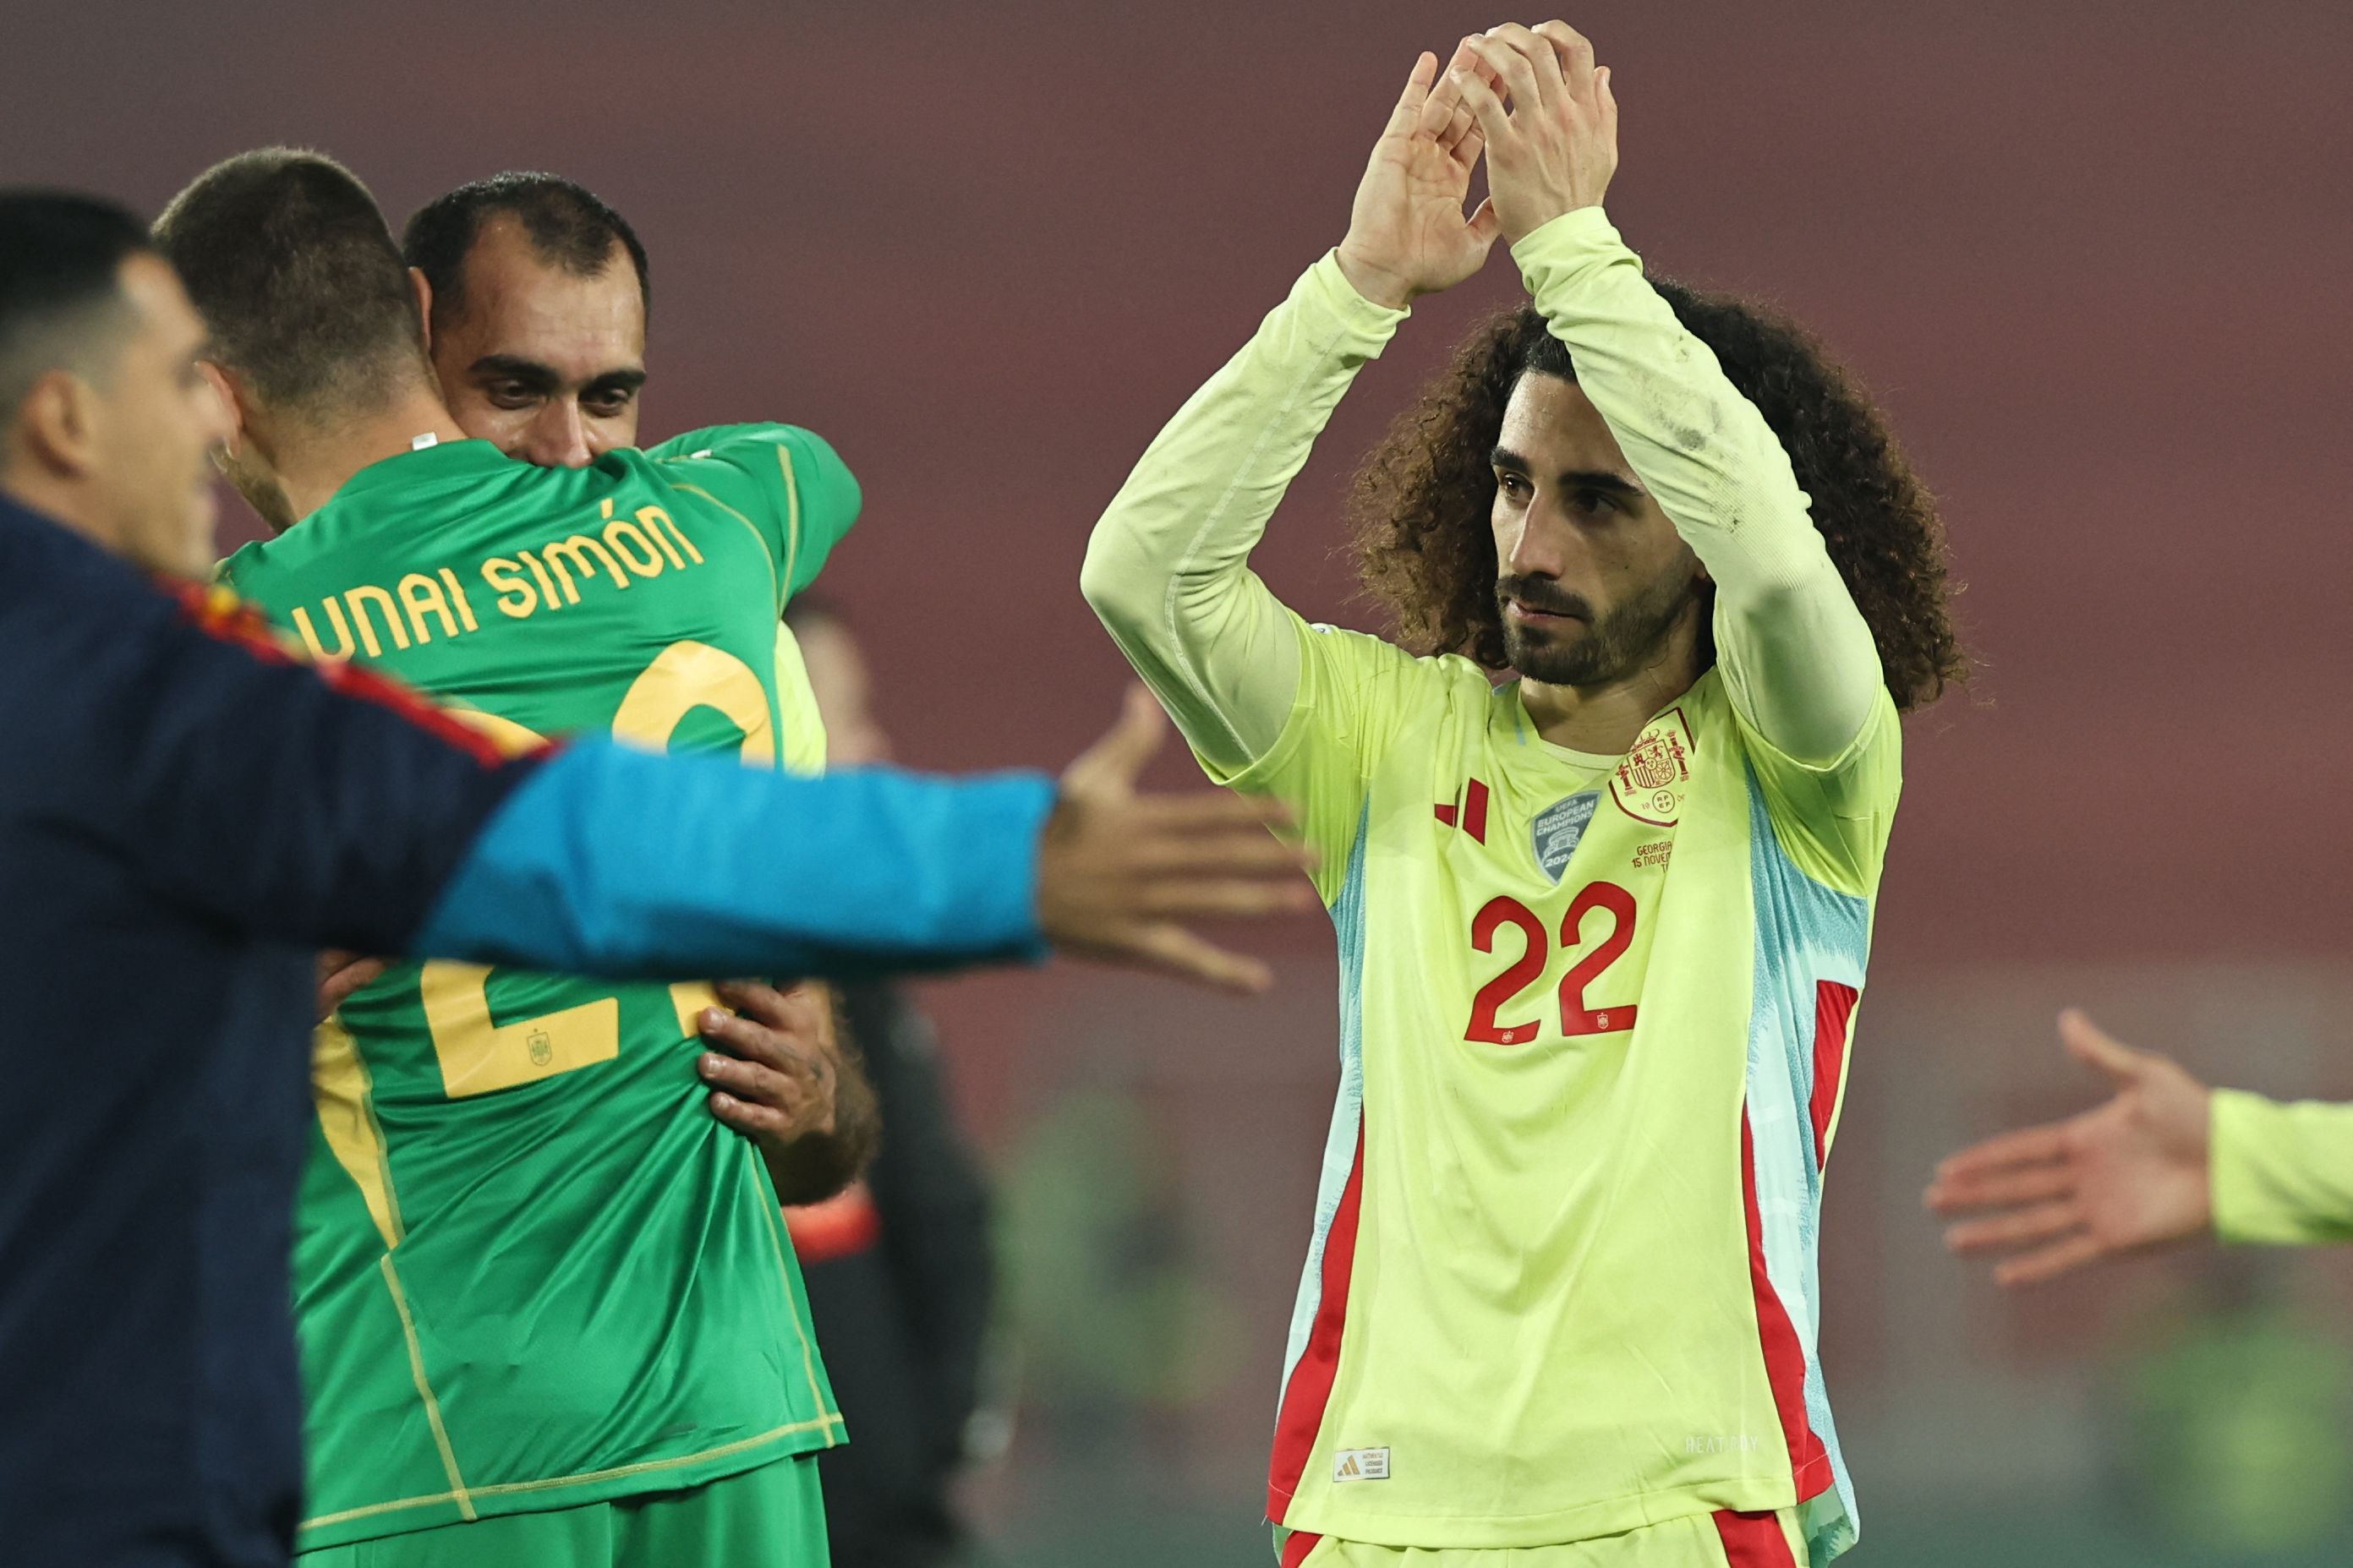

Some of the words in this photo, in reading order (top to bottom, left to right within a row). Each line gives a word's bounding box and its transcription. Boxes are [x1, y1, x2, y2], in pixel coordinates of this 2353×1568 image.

[292, 568, 479, 665] UNAI
[480, 497, 704, 619] SIMÓN
[1536, 810, 1593, 836] CHAMPIONS
[1537, 800, 1595, 828] EUROPEAN
[1636, 840, 1672, 856] GEORGIA
[1632, 857, 1642, 868] 15
[1463, 881, 1638, 1046] 22
